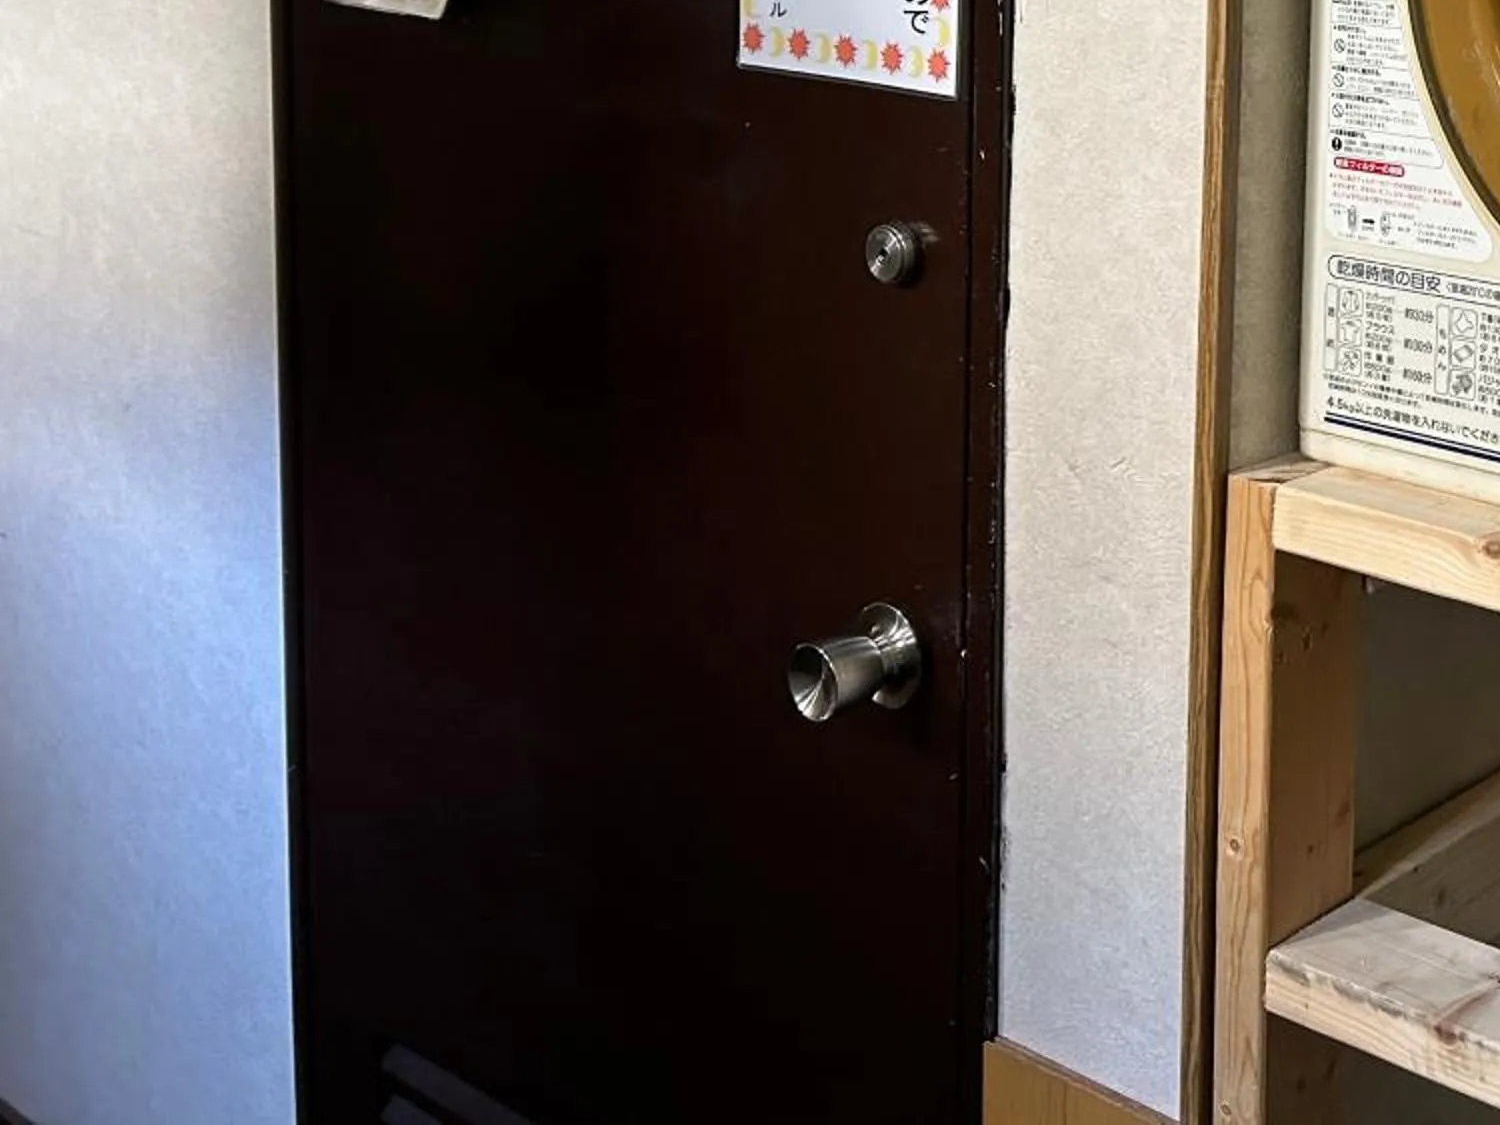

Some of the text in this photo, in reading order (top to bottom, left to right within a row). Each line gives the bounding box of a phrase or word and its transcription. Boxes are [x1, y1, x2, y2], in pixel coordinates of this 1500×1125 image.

[1336, 260, 1441, 294] 乾燥時間の目安
